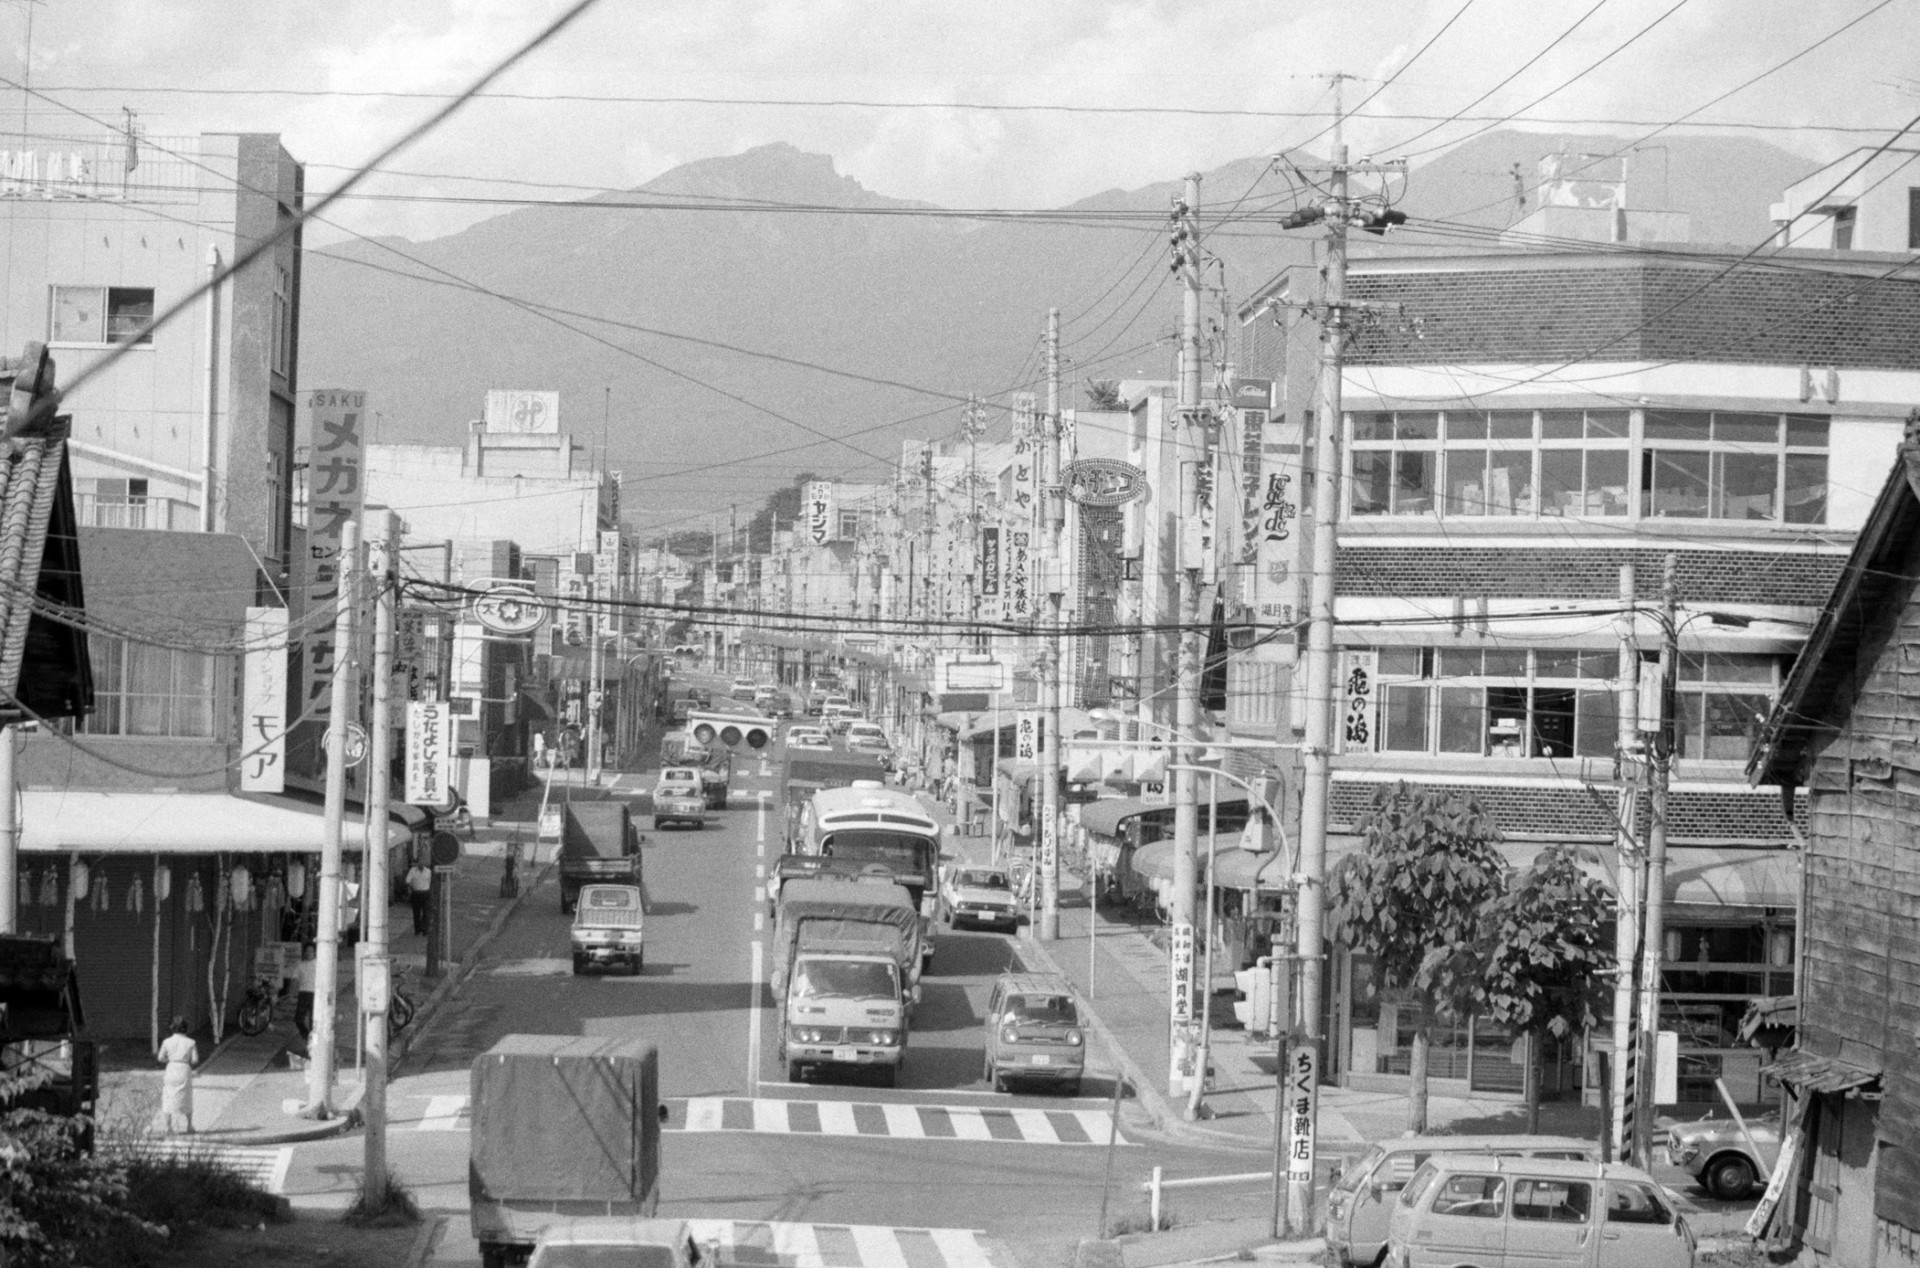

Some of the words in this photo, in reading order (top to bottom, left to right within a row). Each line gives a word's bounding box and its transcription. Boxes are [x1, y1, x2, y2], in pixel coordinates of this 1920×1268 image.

[316, 394, 364, 408] SAKU
[312, 413, 359, 539] メガネ
[1015, 438, 1031, 509] かどや
[1071, 469, 1133, 495] パチンコ
[1242, 411, 1266, 565] 東芝電子レンジ
[812, 500, 828, 543] ヤジマ
[1261, 603, 1293, 618] 湖月堂
[250, 715, 279, 779] モア
[1175, 967, 1189, 1015] 湖月堂
[1293, 1052, 1312, 1160] ちくま靴店
